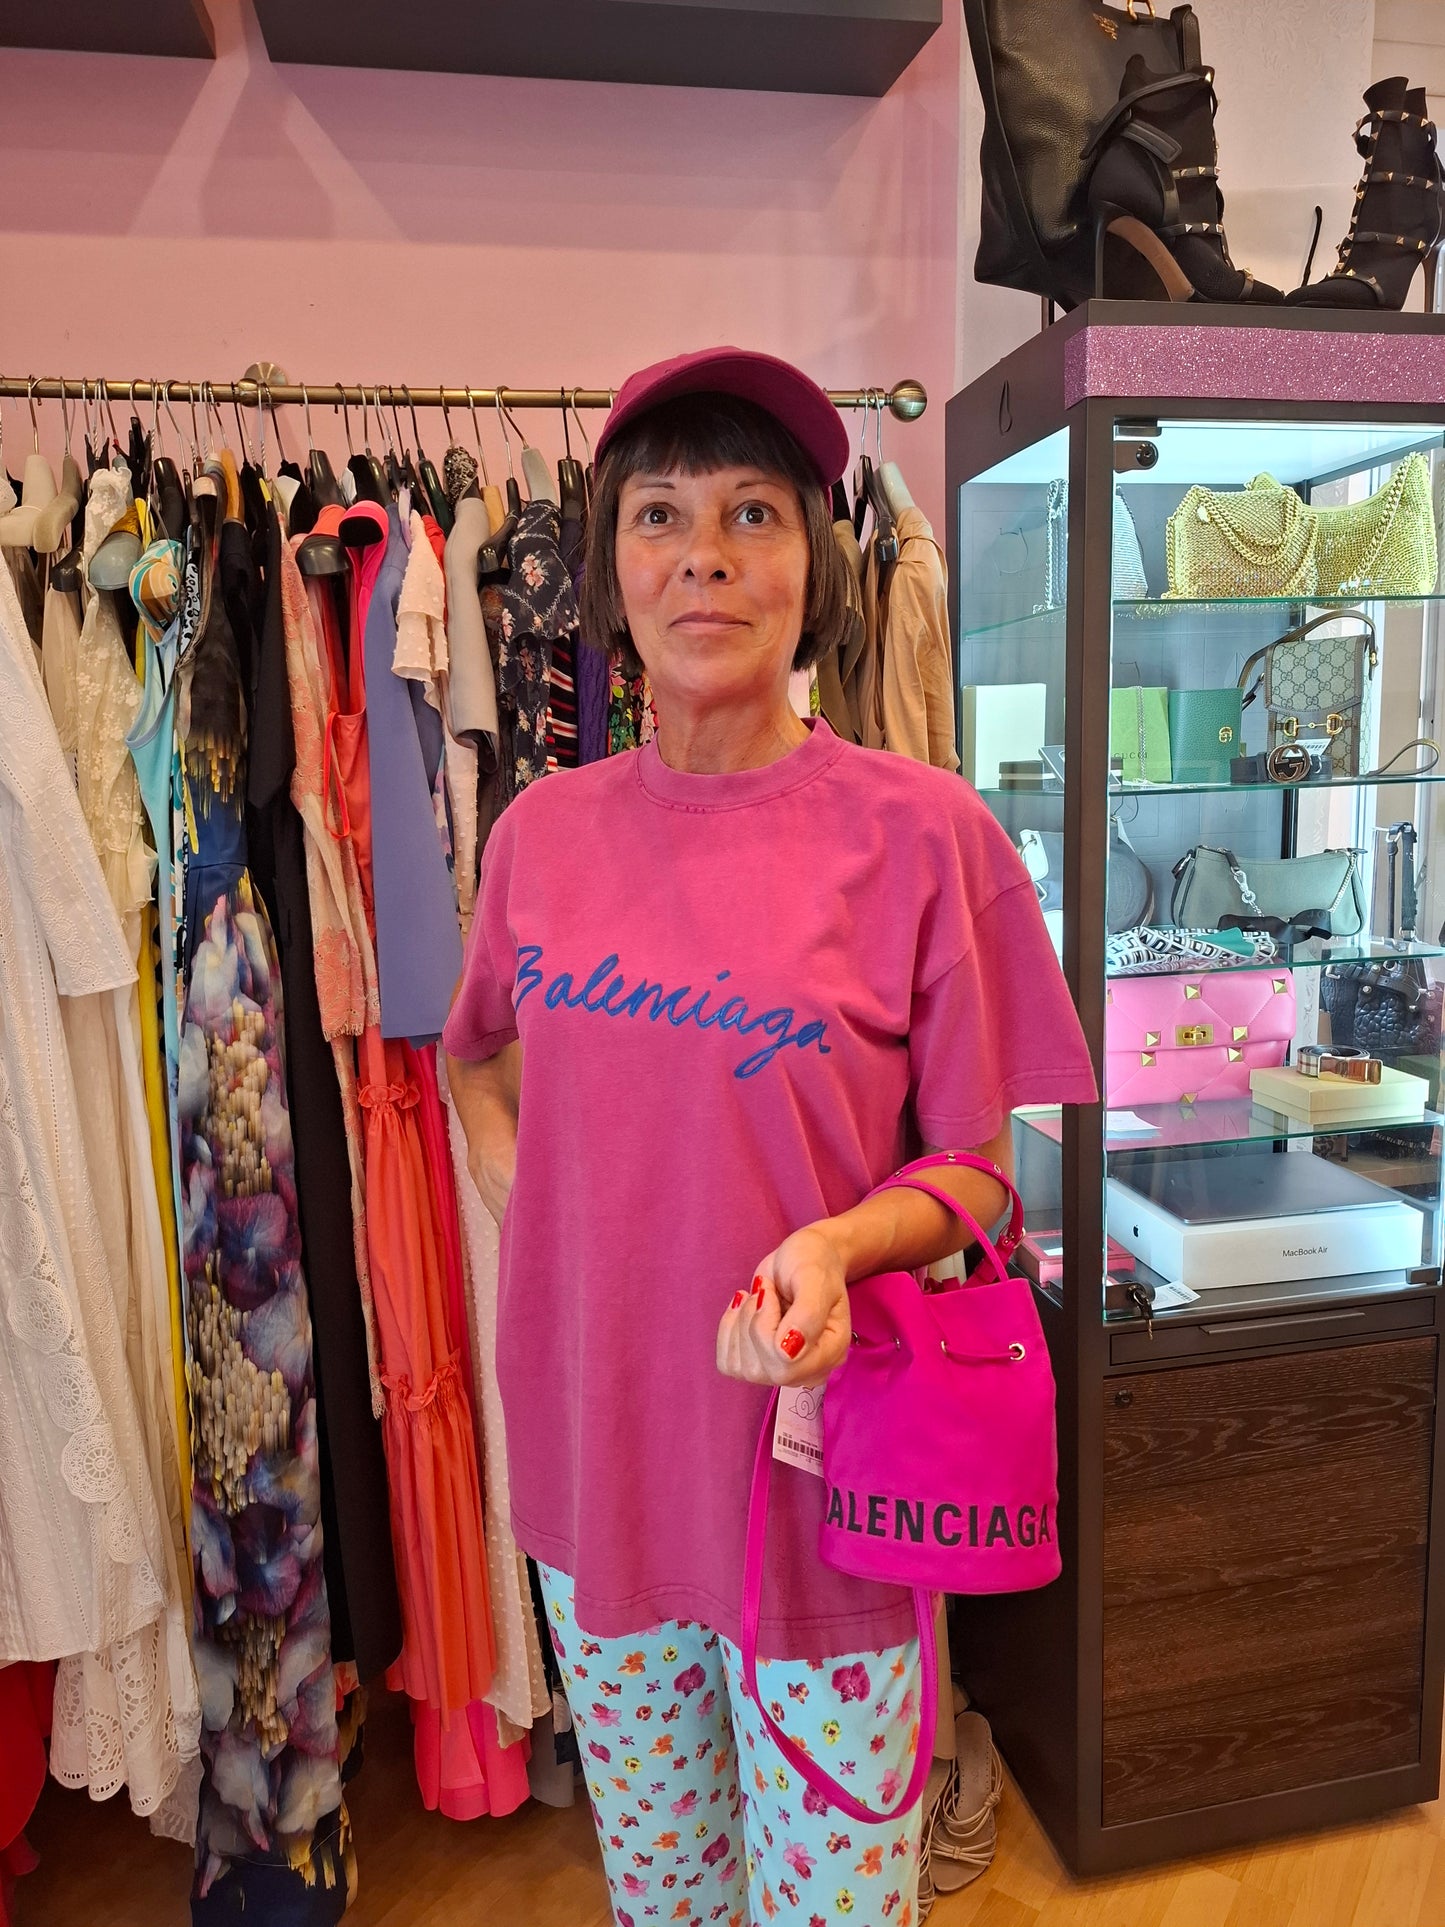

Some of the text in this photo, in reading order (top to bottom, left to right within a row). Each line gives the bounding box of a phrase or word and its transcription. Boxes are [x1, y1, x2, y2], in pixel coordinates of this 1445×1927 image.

[514, 945, 831, 1080] Balenciaga
[1282, 1245, 1328, 1257] MacBook Air
[825, 1486, 1051, 1549] ALENCIAGA
